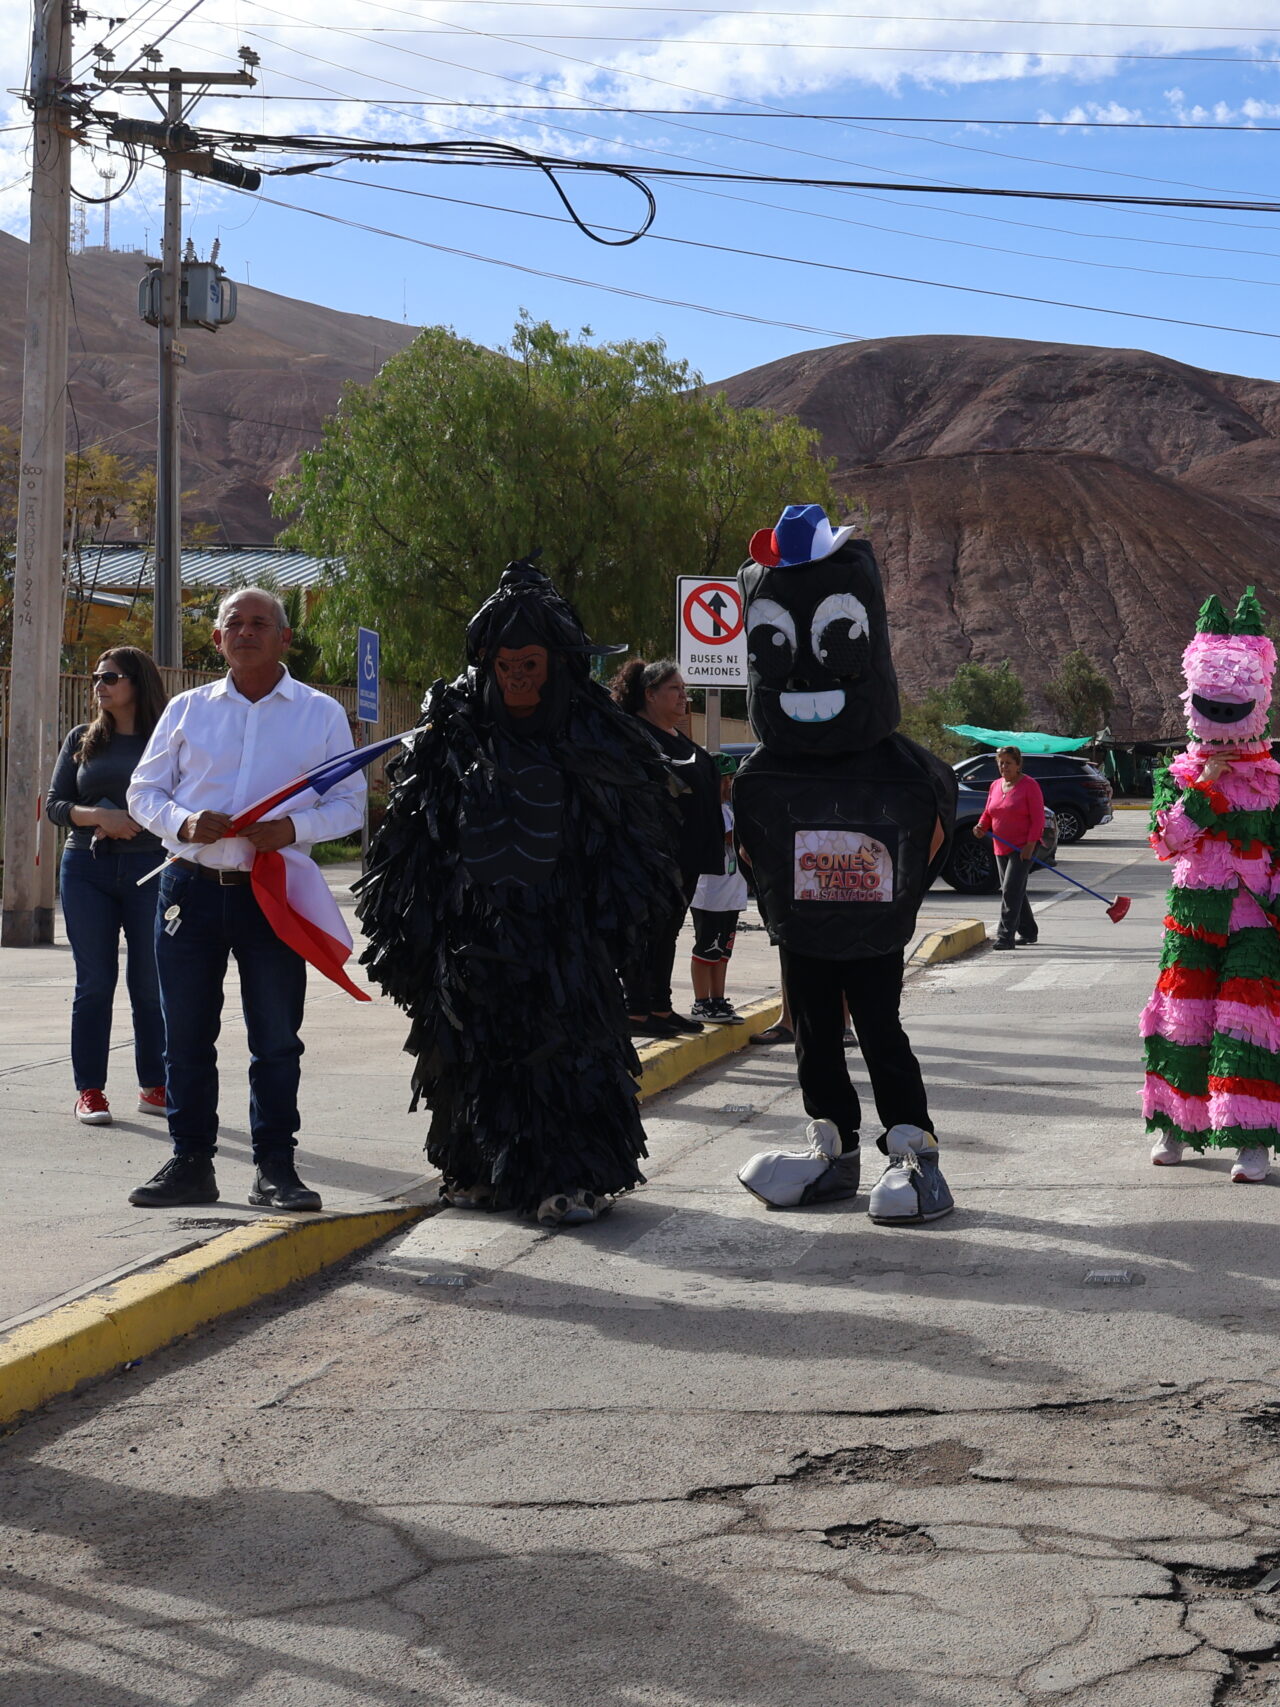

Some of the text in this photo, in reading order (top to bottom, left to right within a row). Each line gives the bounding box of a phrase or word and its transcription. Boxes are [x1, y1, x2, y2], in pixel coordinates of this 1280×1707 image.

[690, 654, 738, 664] BUSES NI
[688, 666, 741, 676] CAMIONES
[816, 871, 880, 889] TADO
[800, 890, 884, 901] EL SALVADOR
